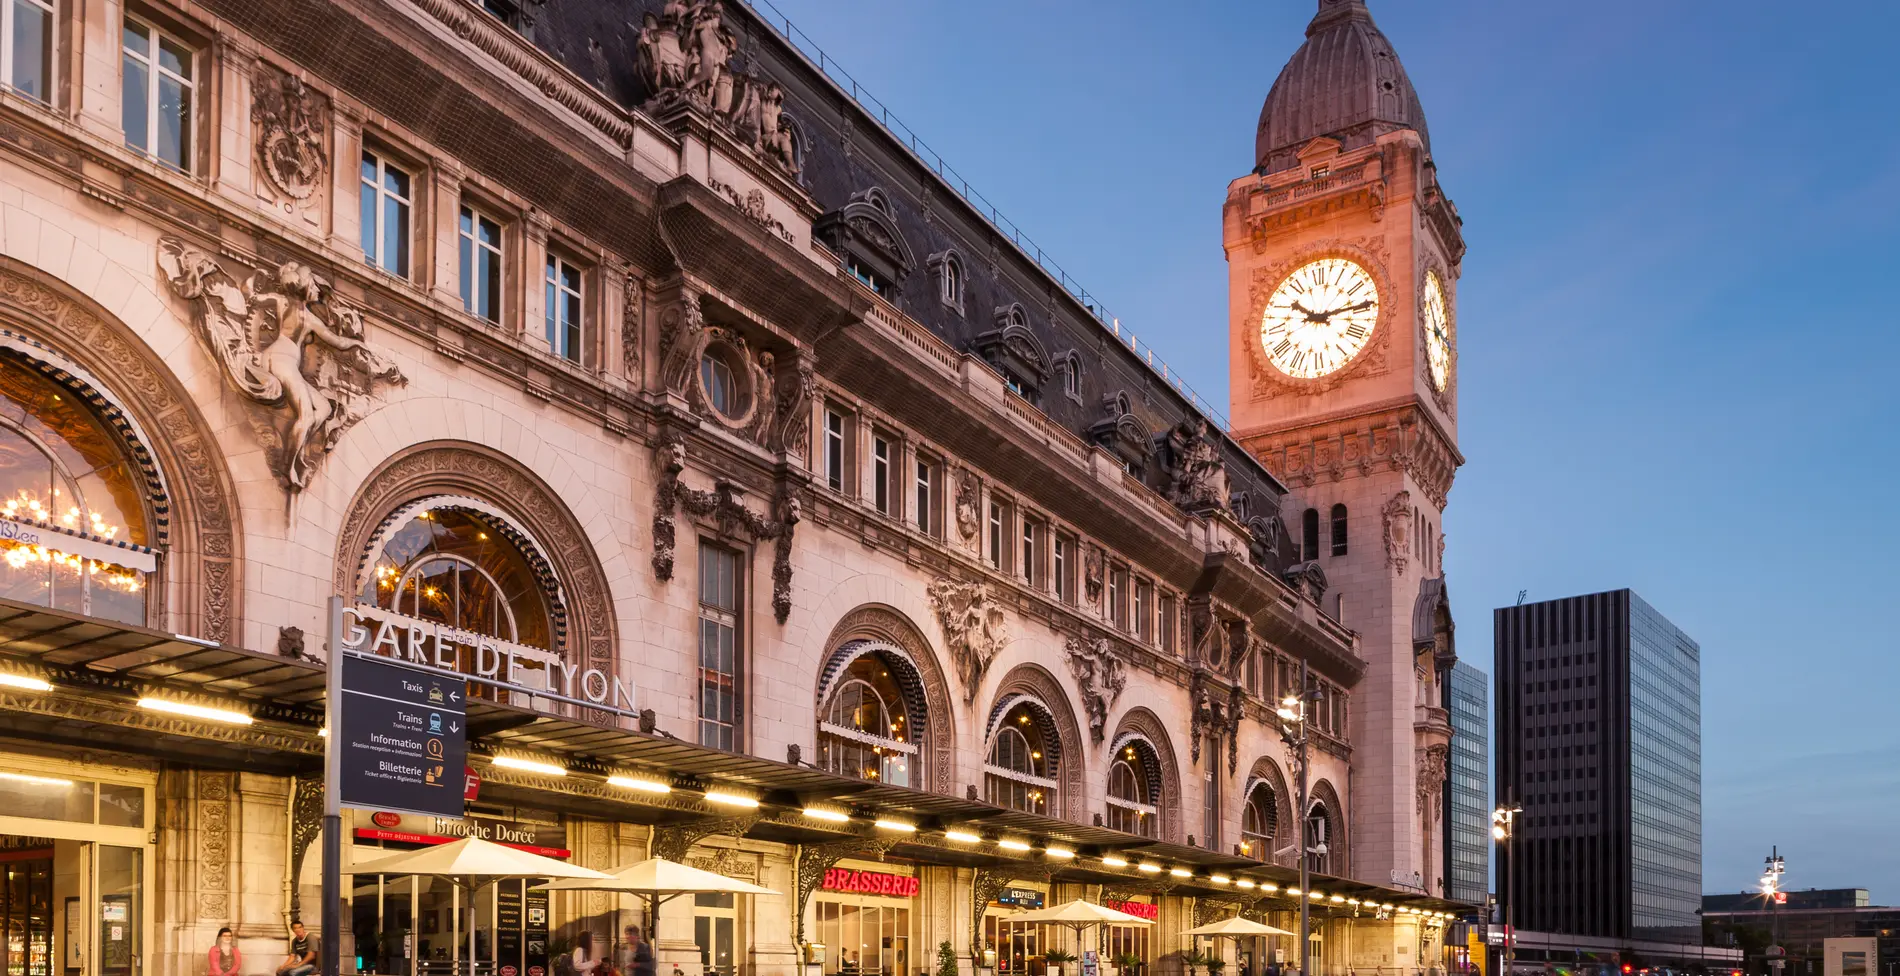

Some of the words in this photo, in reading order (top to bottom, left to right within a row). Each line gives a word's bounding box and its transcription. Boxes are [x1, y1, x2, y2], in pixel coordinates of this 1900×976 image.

[340, 606, 454, 669] GARE
[476, 637, 525, 685] DE
[545, 657, 637, 713] LYON
[401, 680, 424, 693] Taxis
[397, 711, 423, 725] Trains
[352, 742, 370, 750] Station
[370, 744, 391, 754] reception
[370, 732, 423, 750] Information
[364, 770, 379, 778] Ticket
[379, 760, 422, 776] Billetterie
[433, 816, 491, 839] Brioche
[495, 823, 536, 844] Dorée
[822, 867, 920, 896] BRASSERIE
